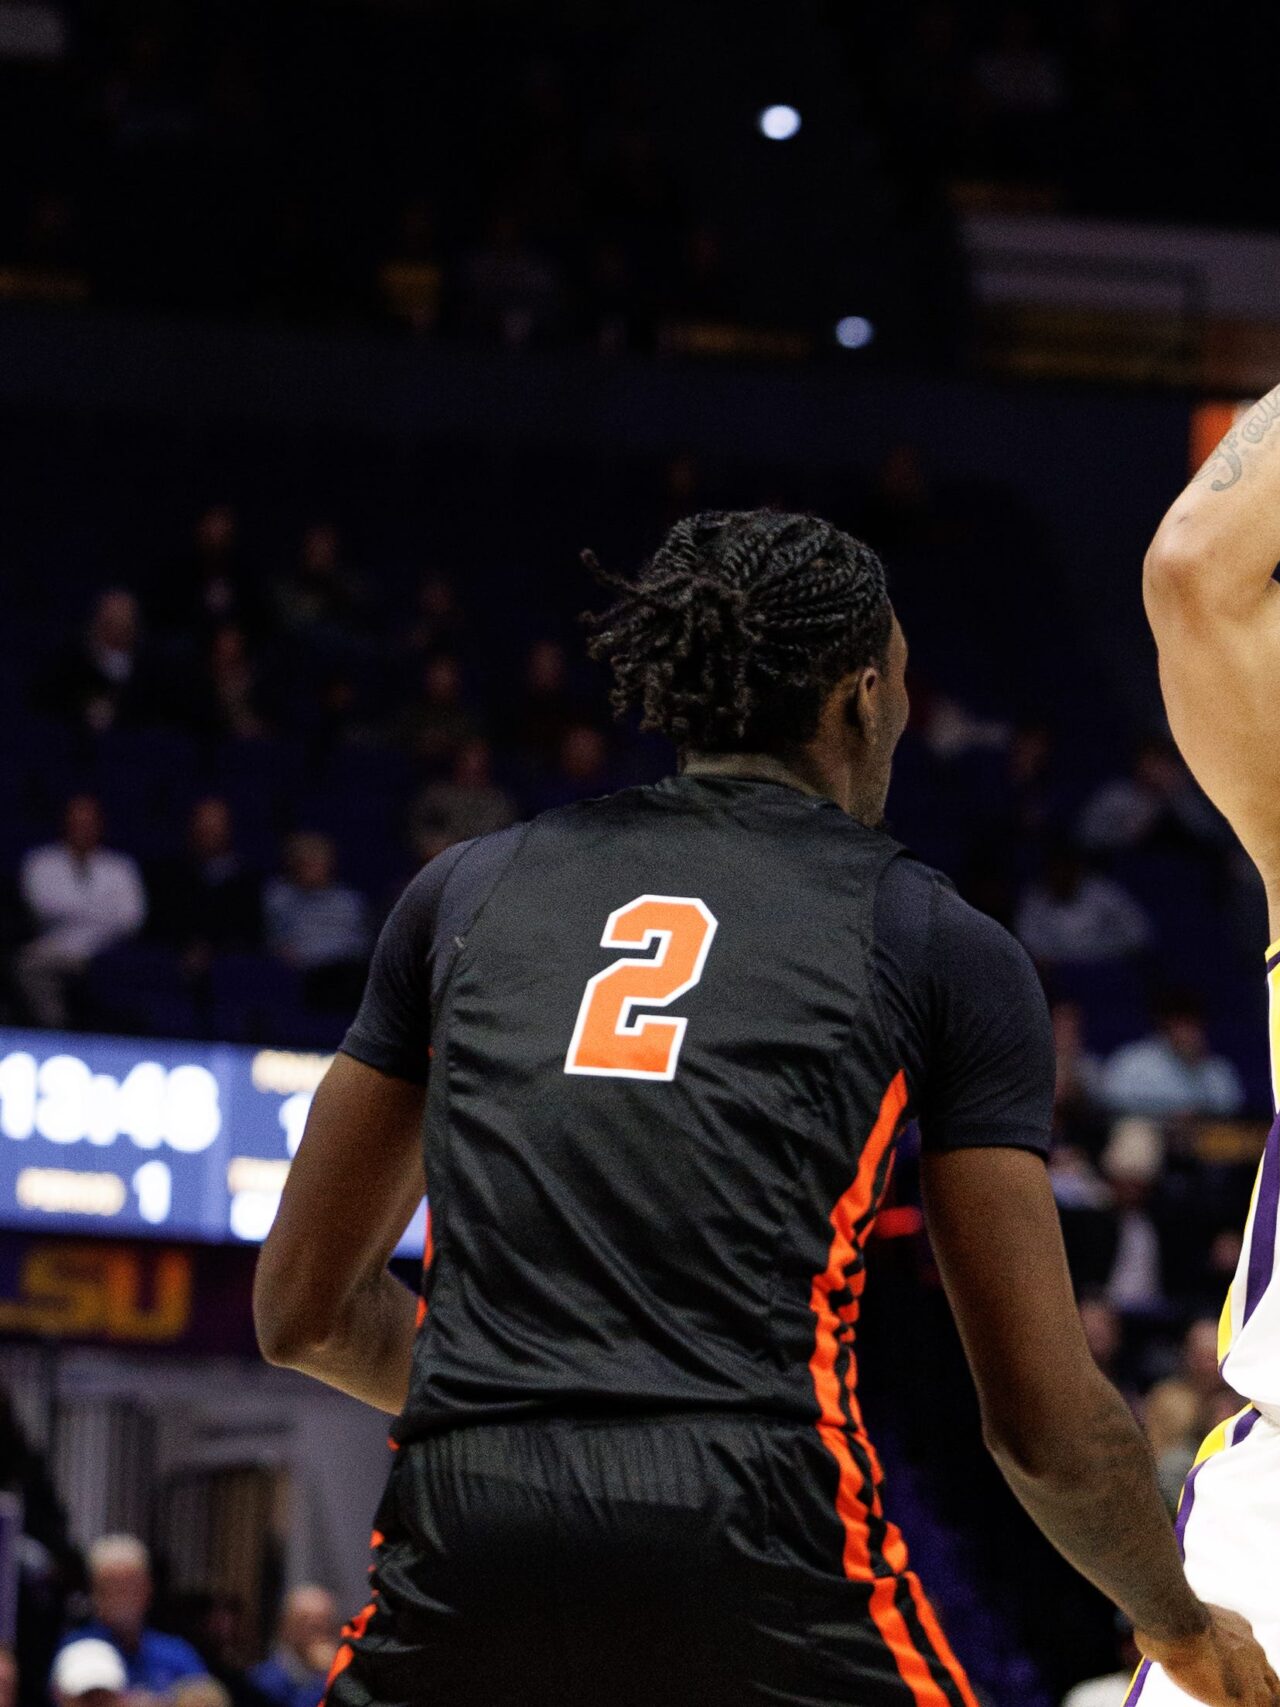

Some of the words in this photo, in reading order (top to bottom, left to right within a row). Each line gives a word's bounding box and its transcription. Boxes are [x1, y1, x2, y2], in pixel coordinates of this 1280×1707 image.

[563, 894, 719, 1081] 2
[133, 1160, 171, 1225] 1
[0, 1245, 193, 1341] SU
